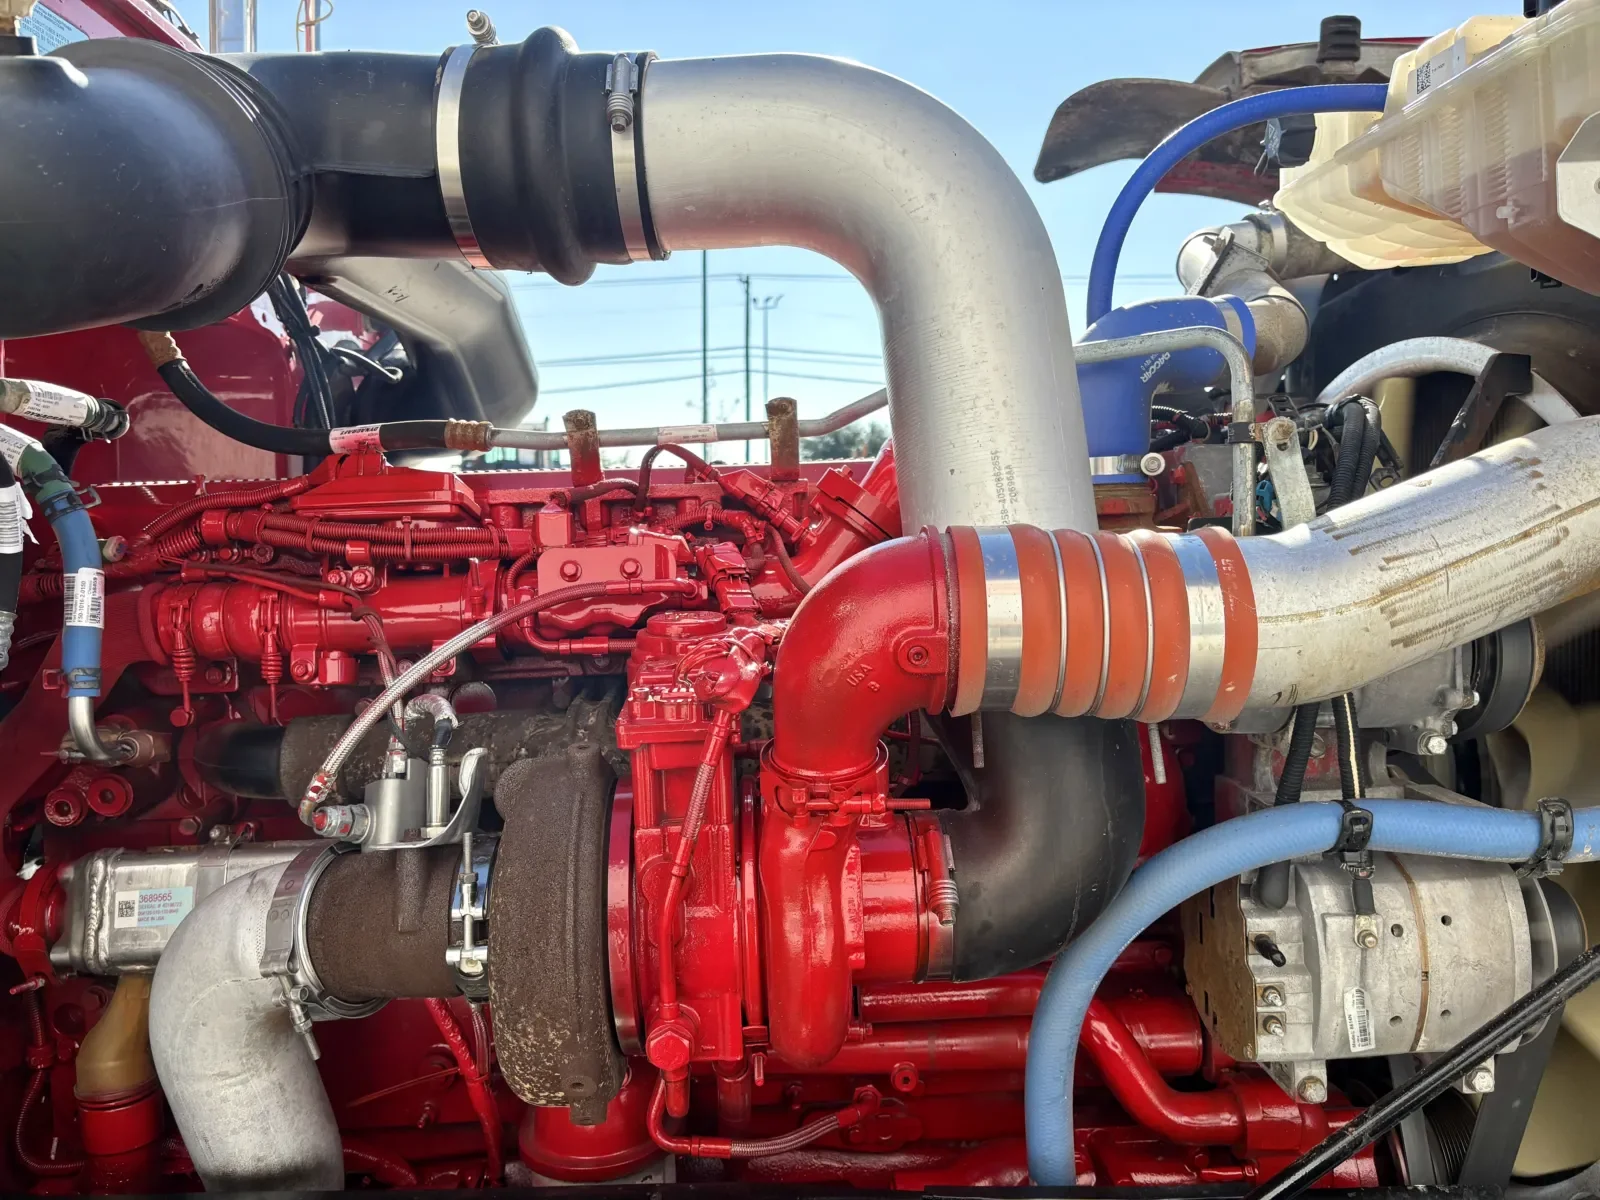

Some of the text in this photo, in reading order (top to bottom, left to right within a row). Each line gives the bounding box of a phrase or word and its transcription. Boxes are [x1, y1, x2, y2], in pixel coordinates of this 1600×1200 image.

[1140, 352, 1170, 382] PACCAR
[846, 664, 873, 687] USA
[139, 892, 172, 903] 3689565
